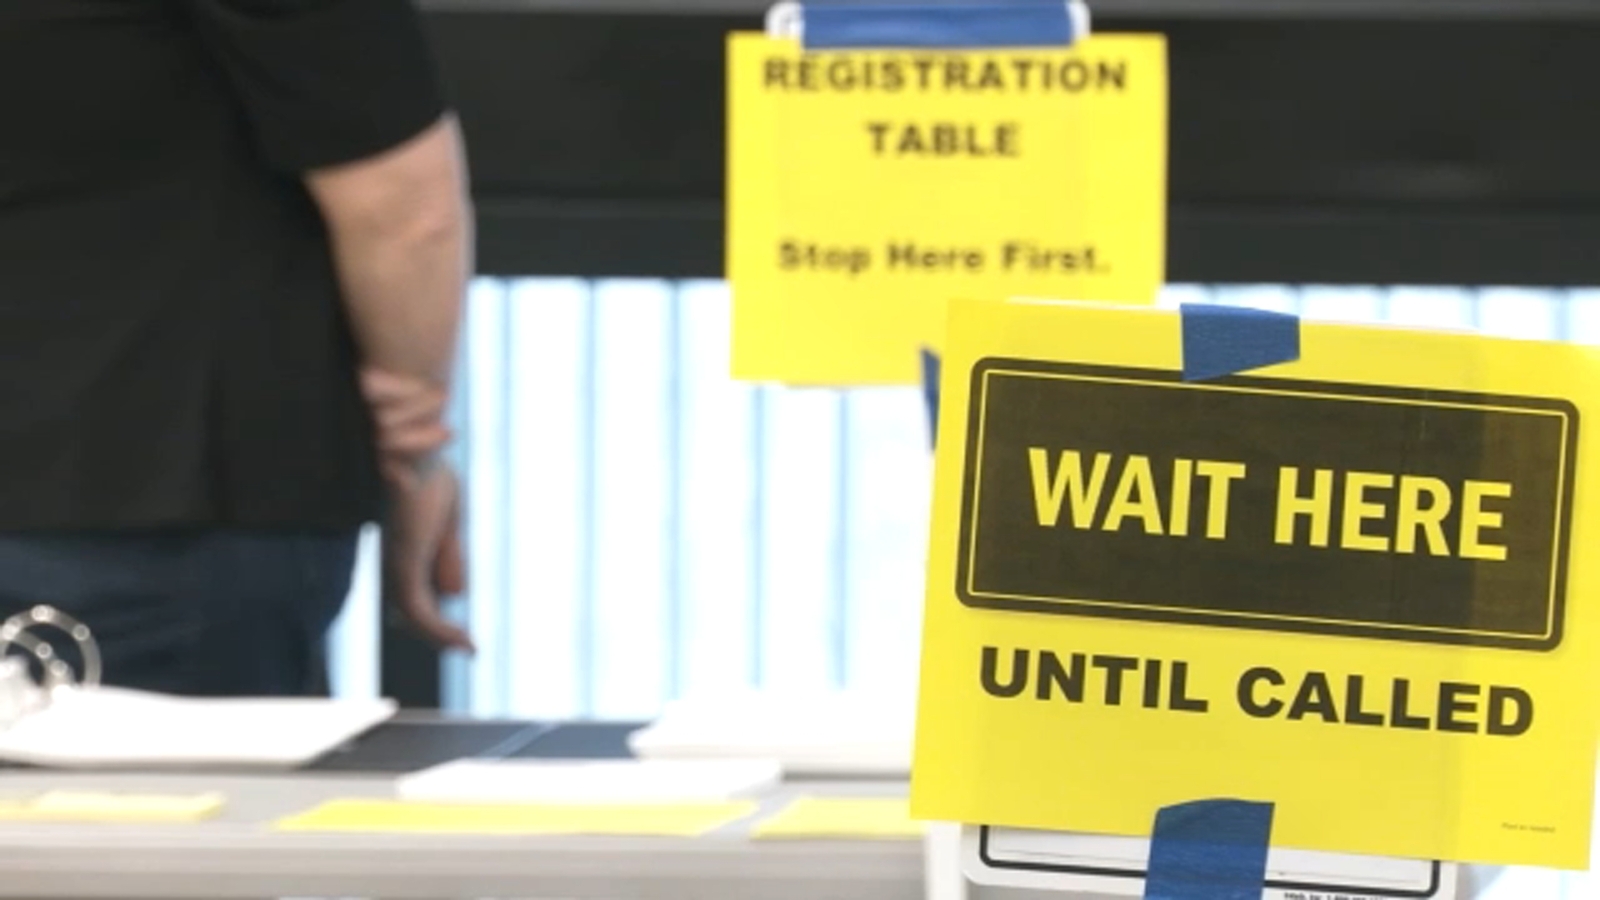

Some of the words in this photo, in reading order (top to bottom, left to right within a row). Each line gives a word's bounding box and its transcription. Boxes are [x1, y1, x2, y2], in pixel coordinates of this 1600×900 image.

[763, 58, 1127, 93] REGISTRATION
[867, 122, 1020, 157] TABLE
[778, 240, 872, 277] Stop
[886, 242, 985, 272] Here
[1000, 241, 1110, 273] First.
[1029, 448, 1246, 539] WAIT
[1275, 467, 1512, 561] HERE
[980, 646, 1210, 714] UNTIL
[1237, 667, 1534, 737] CALLED
